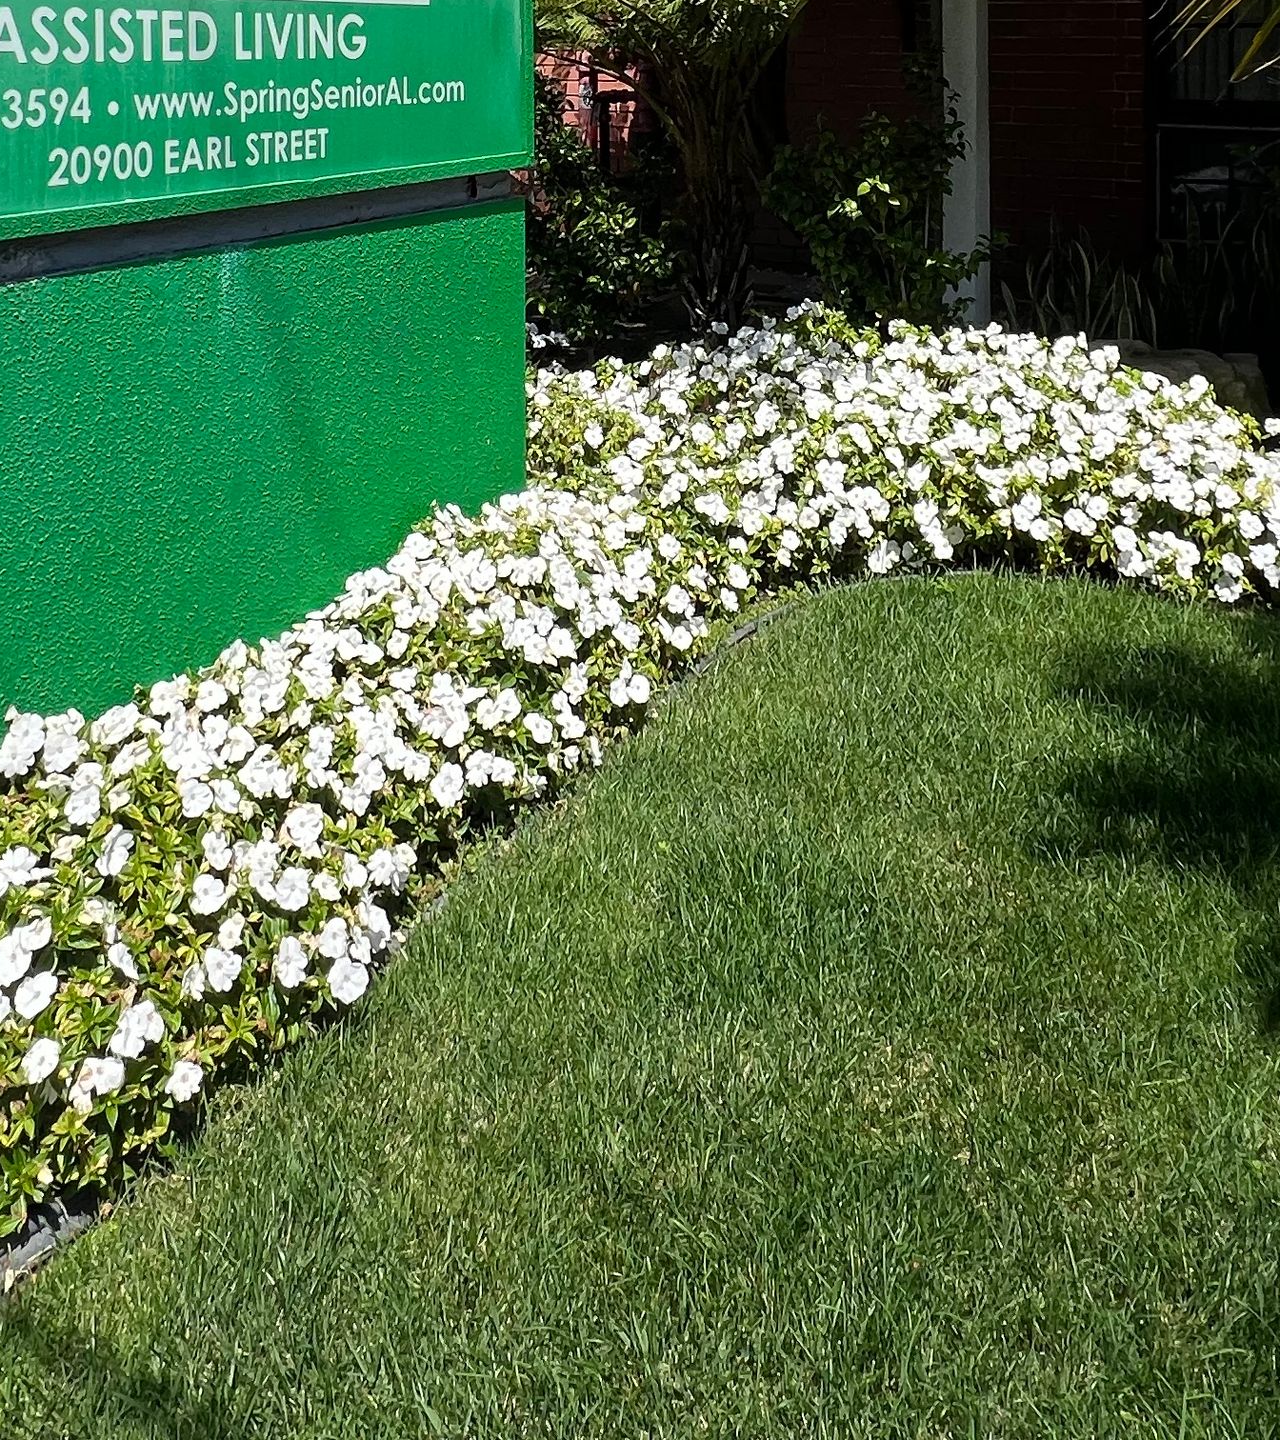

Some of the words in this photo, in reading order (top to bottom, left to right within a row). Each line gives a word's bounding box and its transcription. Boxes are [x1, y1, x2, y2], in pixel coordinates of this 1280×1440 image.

[235, 12, 367, 61] LIVING
[133, 76, 465, 123] www.SpringSeniorAL.com
[47, 141, 153, 187] 20900
[165, 136, 237, 174] EARL
[245, 128, 329, 166] STREET
